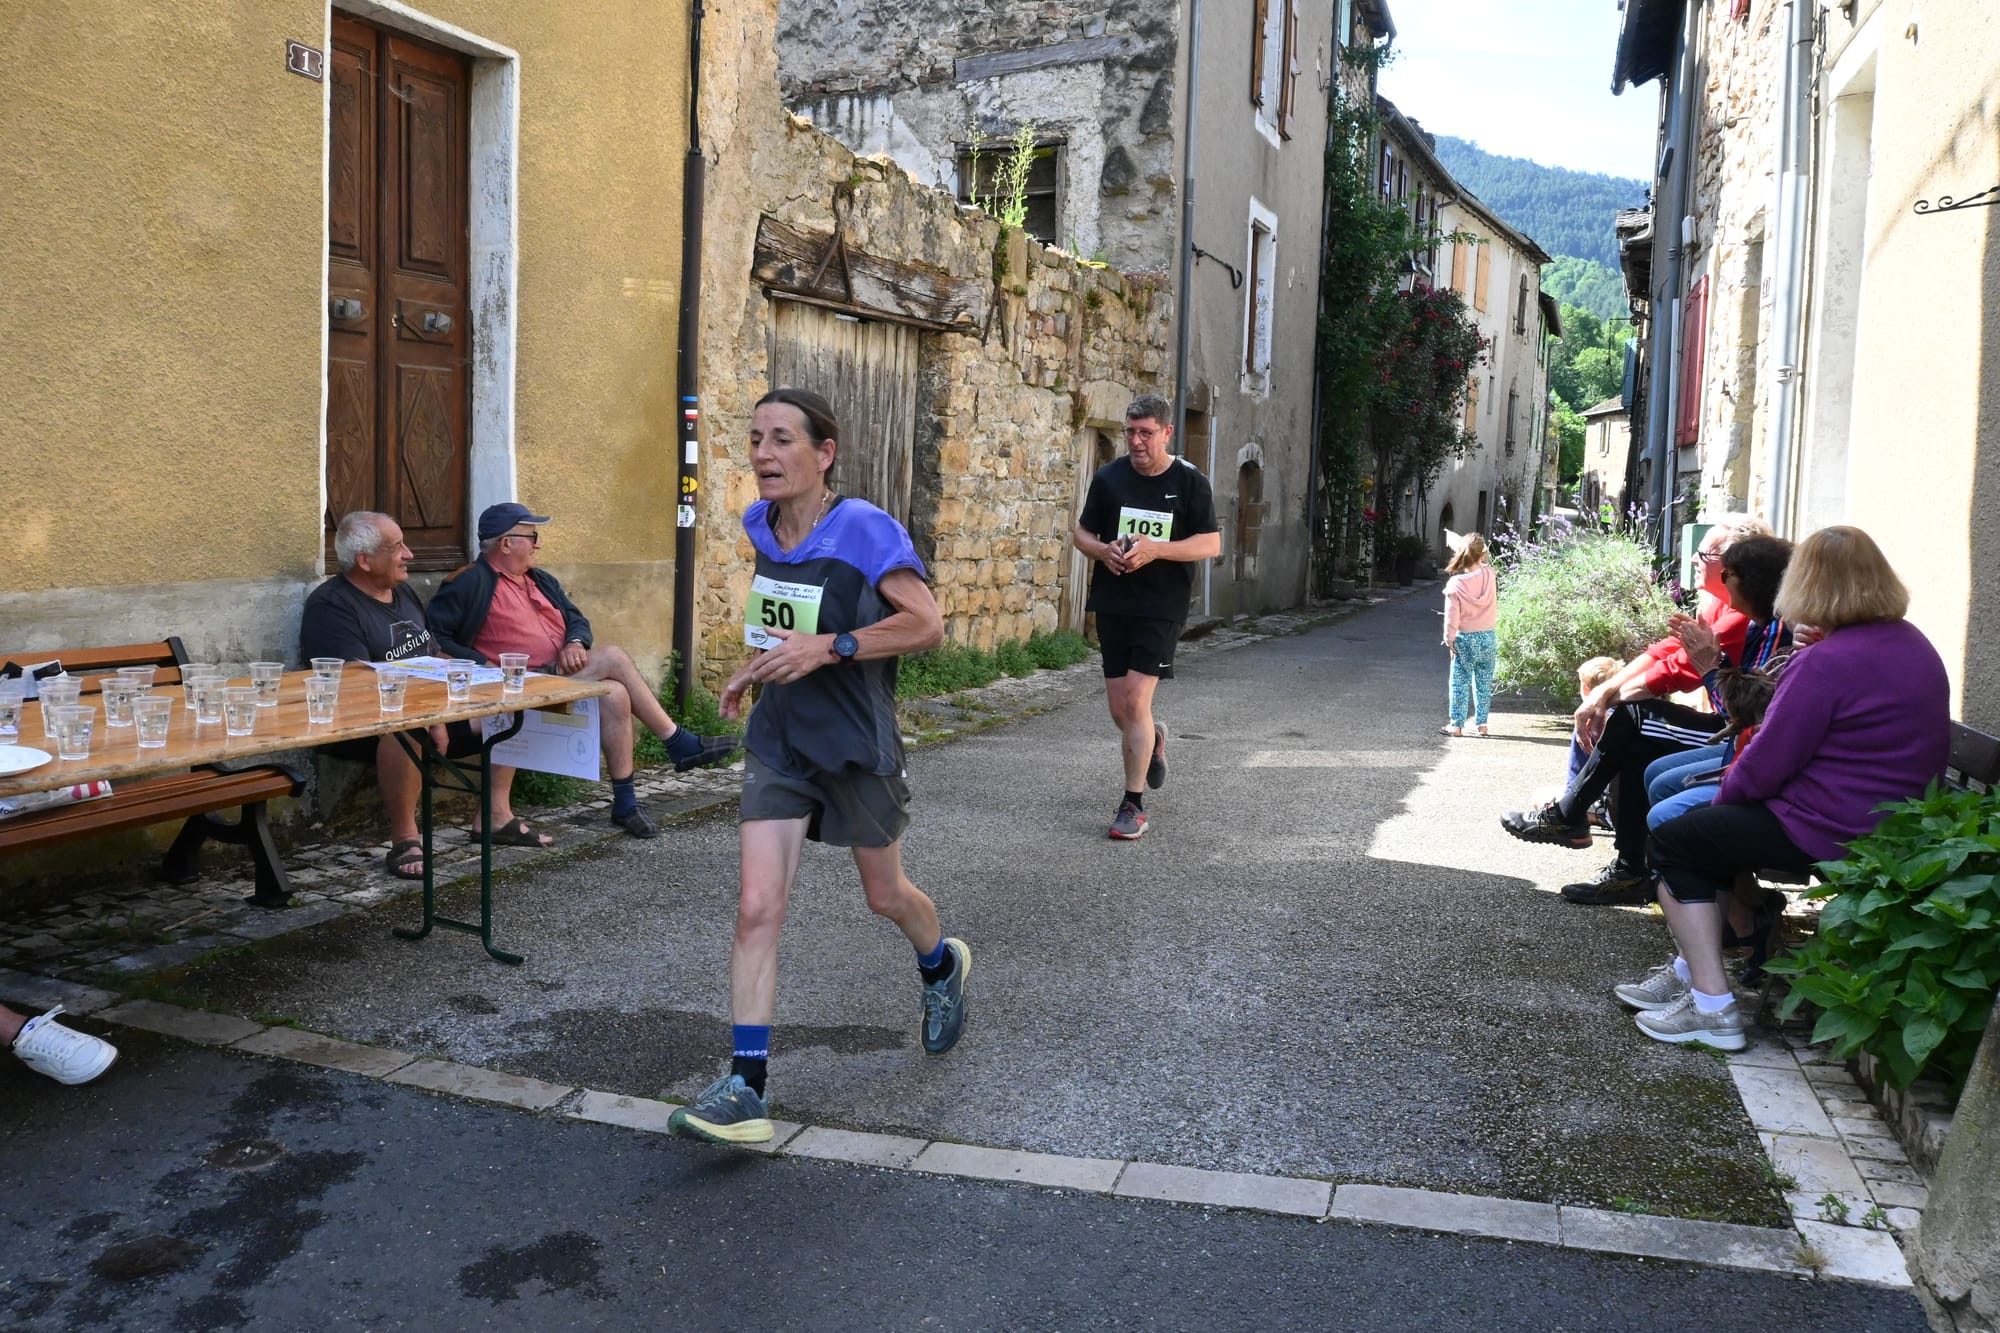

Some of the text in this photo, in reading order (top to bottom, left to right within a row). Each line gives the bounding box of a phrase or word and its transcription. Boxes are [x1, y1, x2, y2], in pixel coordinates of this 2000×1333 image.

[302, 51, 310, 71] 1
[1127, 518, 1163, 537] 103
[761, 598, 795, 630] 50
